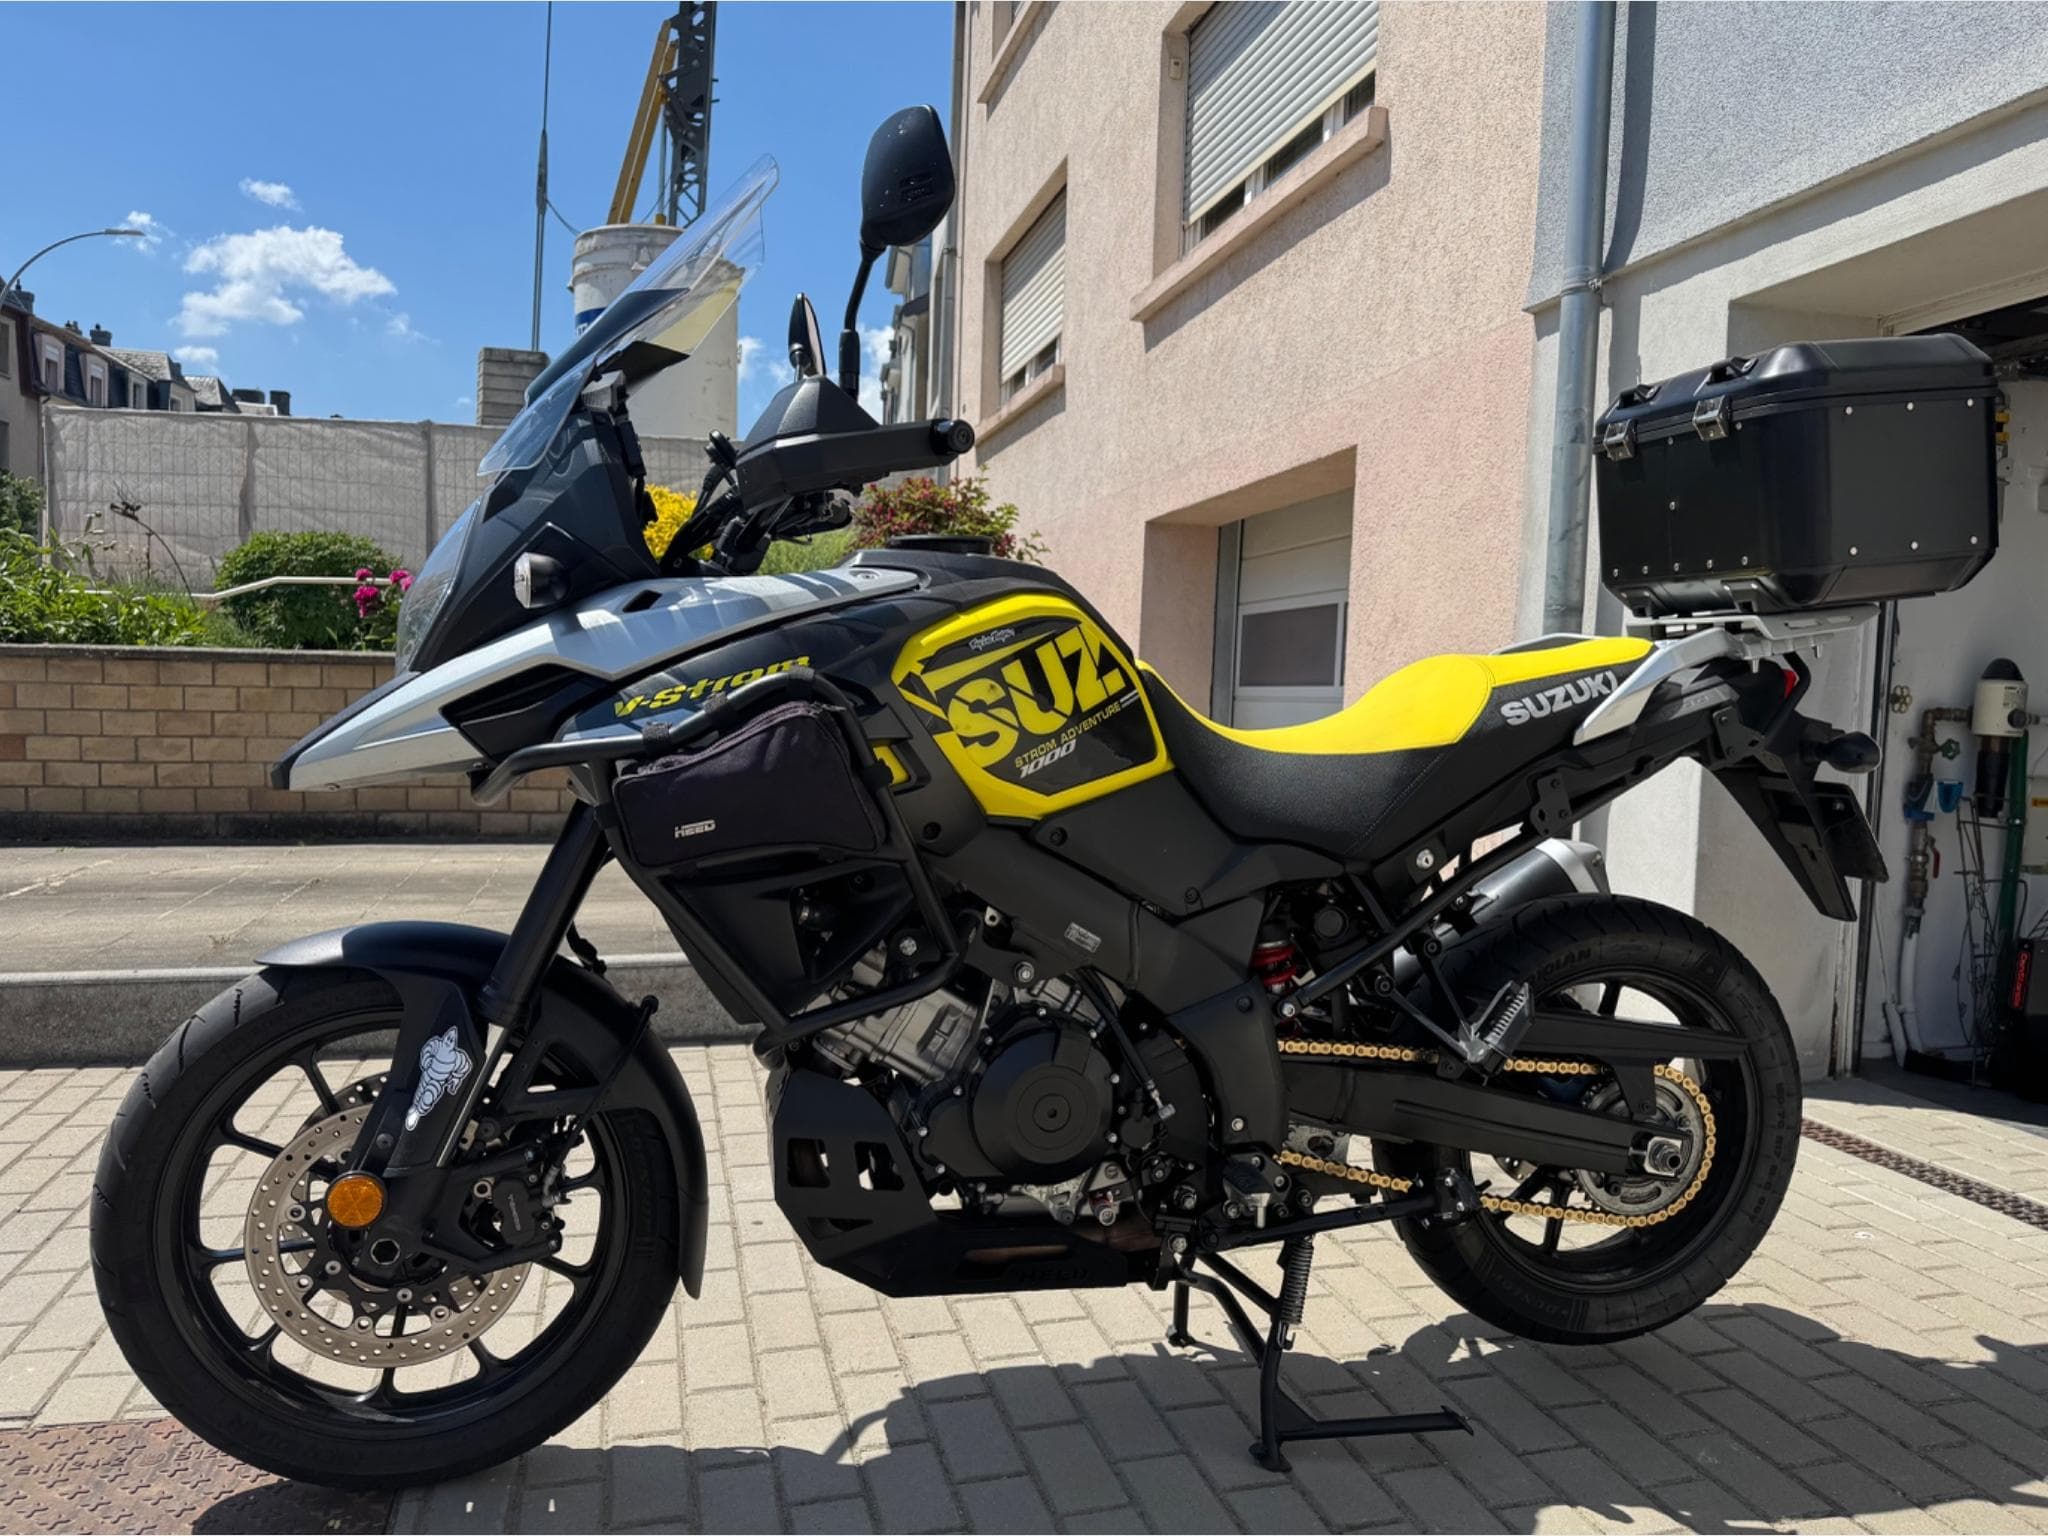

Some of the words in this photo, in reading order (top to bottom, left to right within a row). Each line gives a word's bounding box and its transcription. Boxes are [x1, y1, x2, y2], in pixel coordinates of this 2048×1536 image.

[948, 626, 1126, 768] SUZ
[1500, 670, 1619, 726] SUZUKI
[1014, 739, 1056, 768] STROM
[1060, 702, 1122, 745] ADVENTURE
[1019, 739, 1077, 779] 1000
[675, 819, 716, 838] HEED
